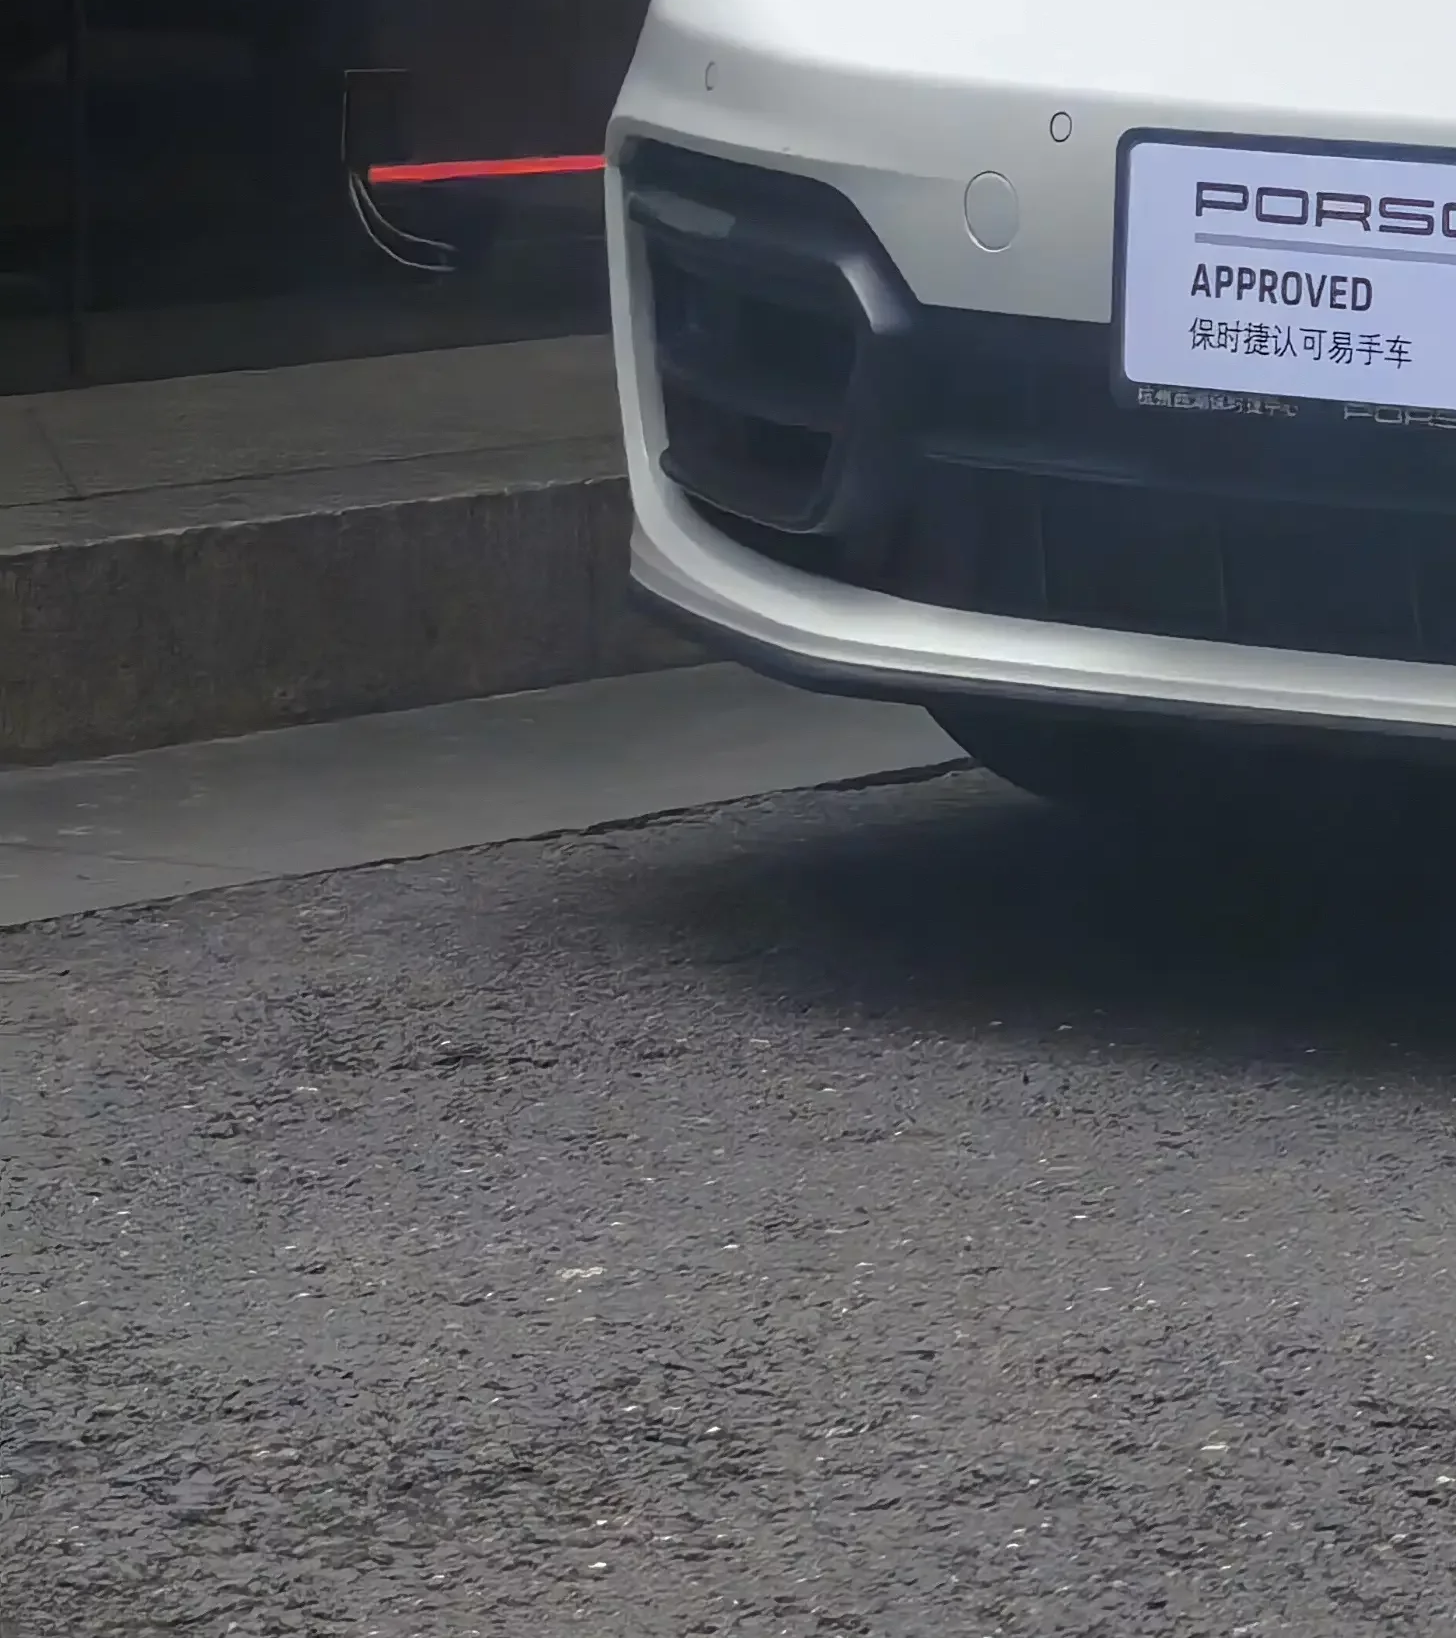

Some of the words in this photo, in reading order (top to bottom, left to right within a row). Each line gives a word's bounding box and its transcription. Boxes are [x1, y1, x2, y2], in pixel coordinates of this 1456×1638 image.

[1190, 262, 1374, 313] APPROVED
[1188, 316, 1413, 370] 保时捷认可易手车
